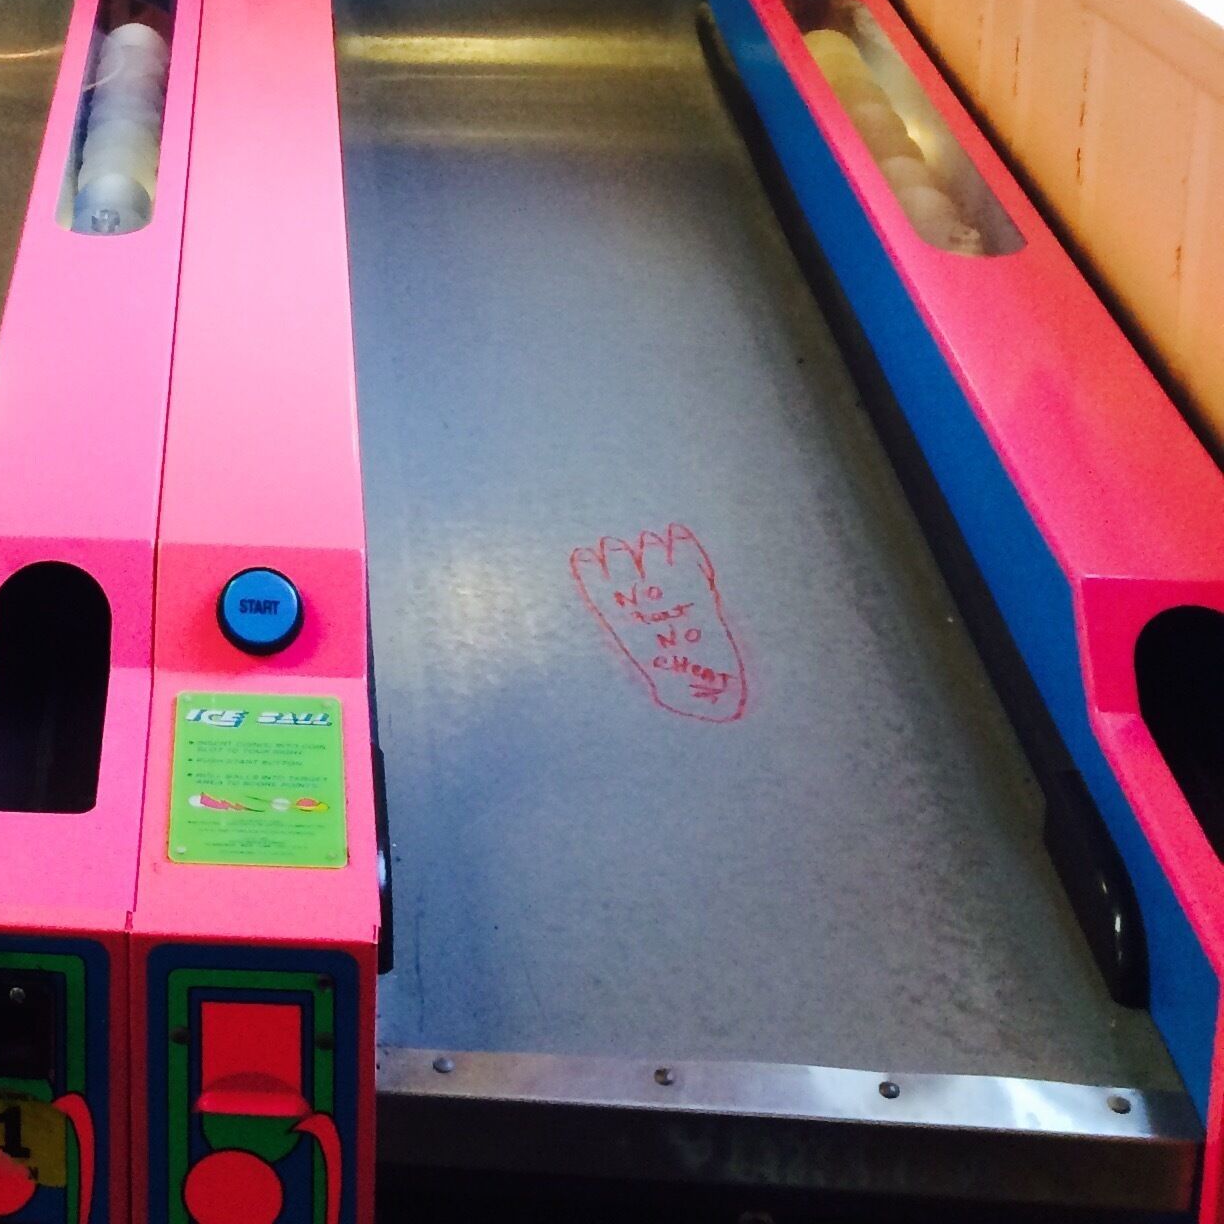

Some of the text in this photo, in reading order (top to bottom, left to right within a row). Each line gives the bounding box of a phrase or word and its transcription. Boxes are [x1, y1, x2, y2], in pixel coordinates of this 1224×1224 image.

[239, 598, 280, 616] START
[185, 708, 333, 728] ICE BALL
